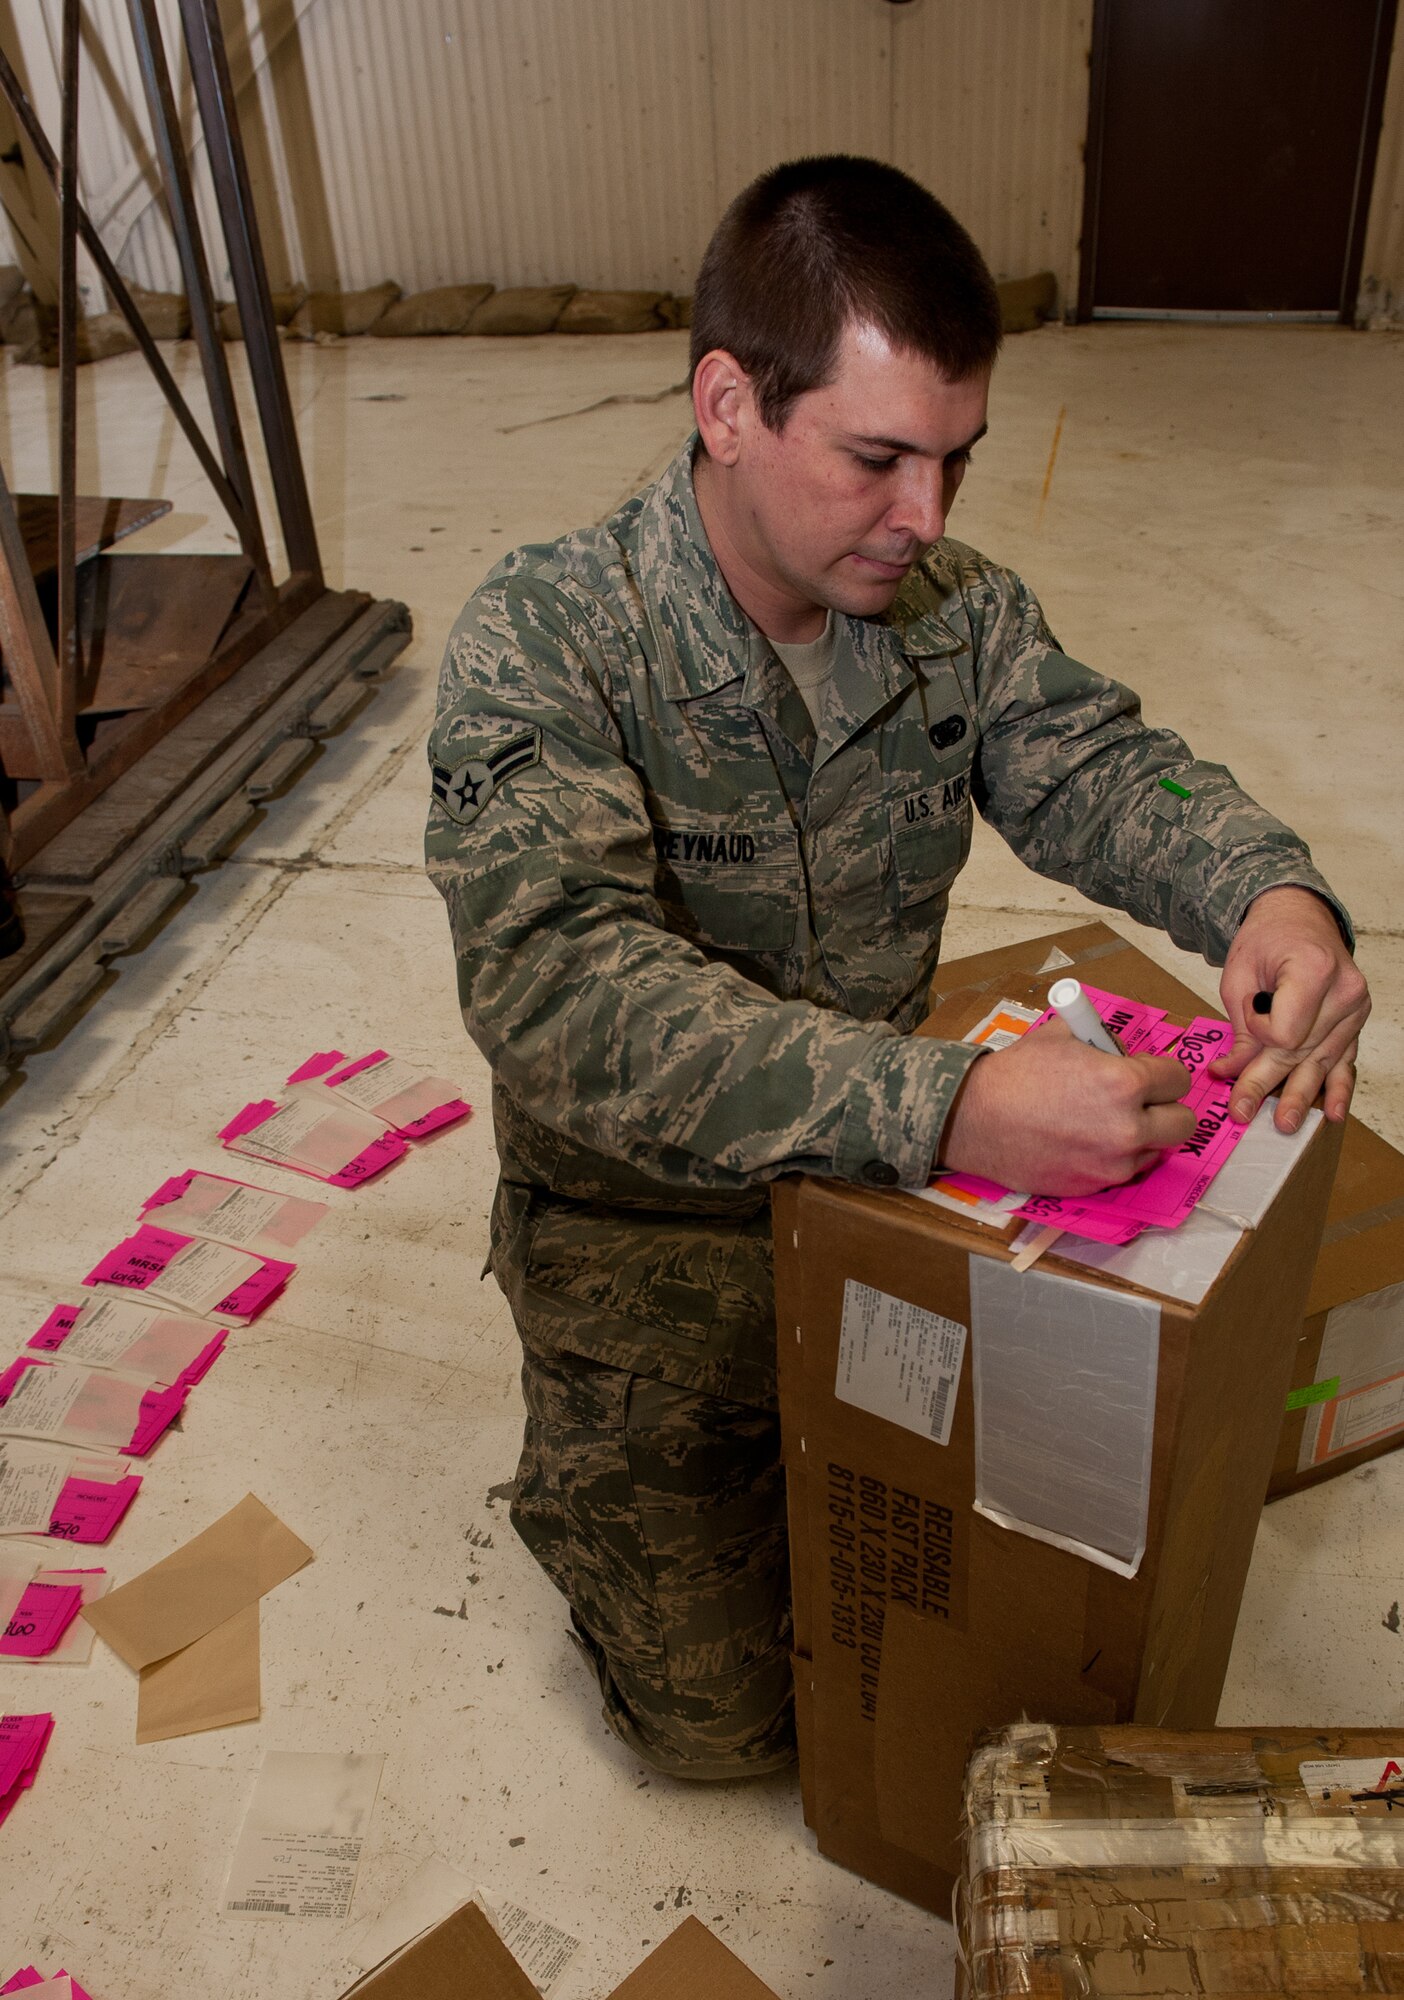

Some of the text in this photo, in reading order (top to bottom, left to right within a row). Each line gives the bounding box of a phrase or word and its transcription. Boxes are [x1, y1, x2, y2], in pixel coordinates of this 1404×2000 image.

[904, 777, 966, 823] U.S. AIR
[655, 830, 755, 863] REYNAUD
[1182, 1174, 1210, 1209] INCHECKER
[859, 1475, 887, 1520] 660
[860, 1520, 886, 1544] X
[890, 1487, 920, 1608] FAST PACK
[827, 1462, 857, 1649] 8115-01-015-1313
[860, 1541, 886, 1583] 230
[922, 1501, 953, 1619] REUSABLE
[860, 1583, 886, 1605] X
[860, 1602, 885, 1641] 230
